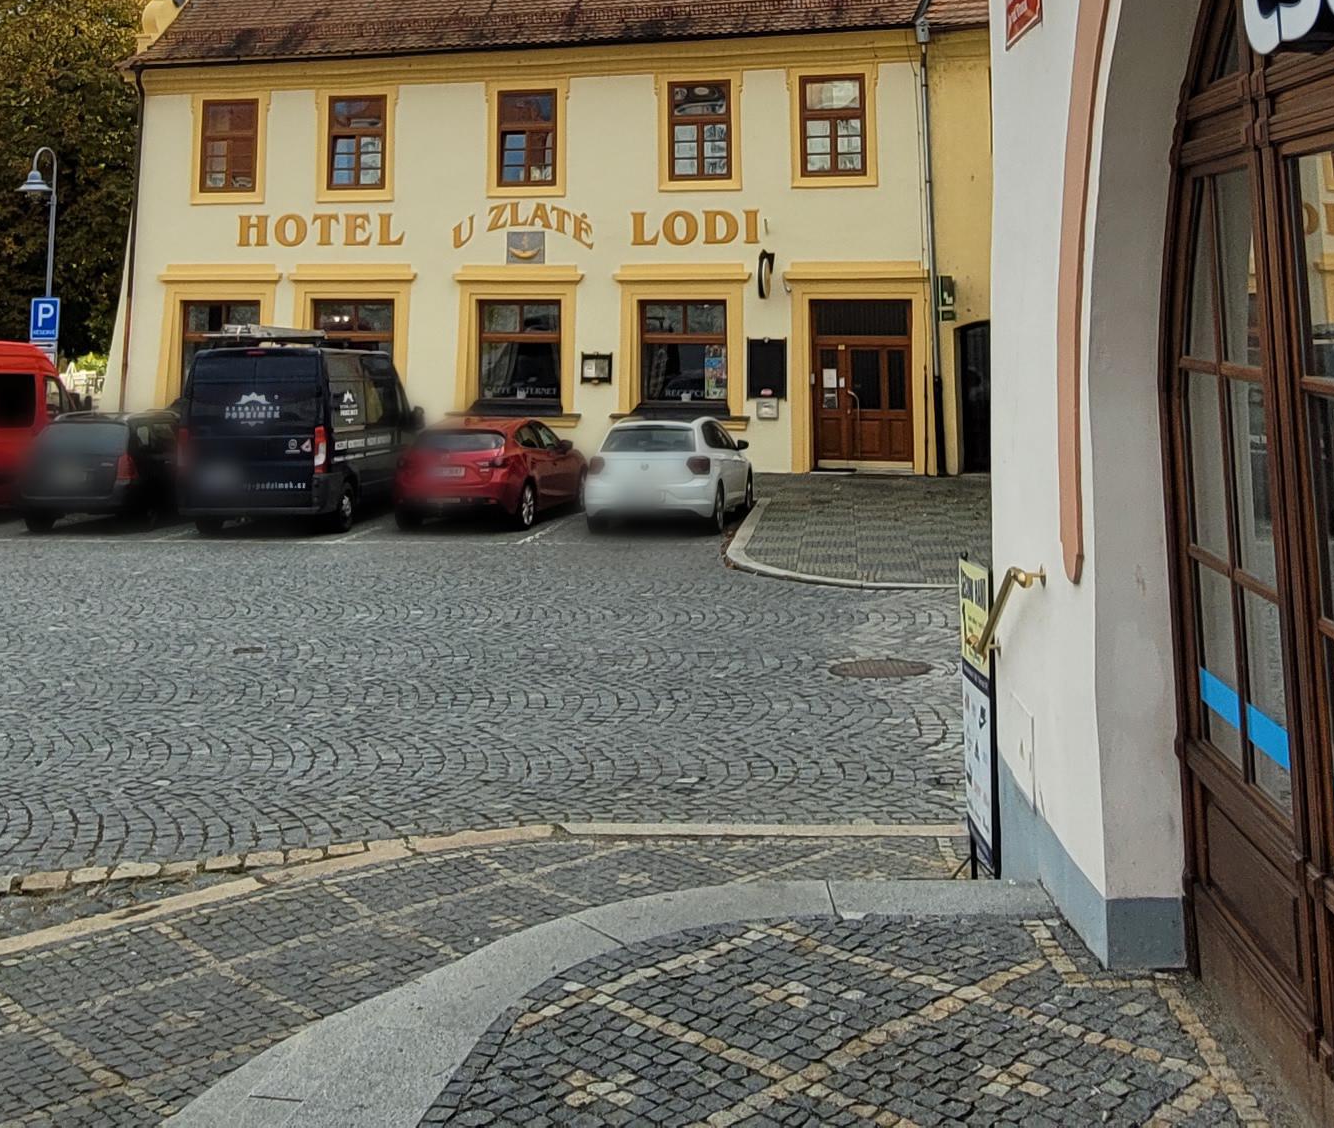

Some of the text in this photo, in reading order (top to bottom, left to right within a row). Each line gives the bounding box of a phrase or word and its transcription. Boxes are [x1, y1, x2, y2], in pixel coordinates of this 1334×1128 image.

[236, 201, 759, 249] HOTEL U ZLATÉ LODI
